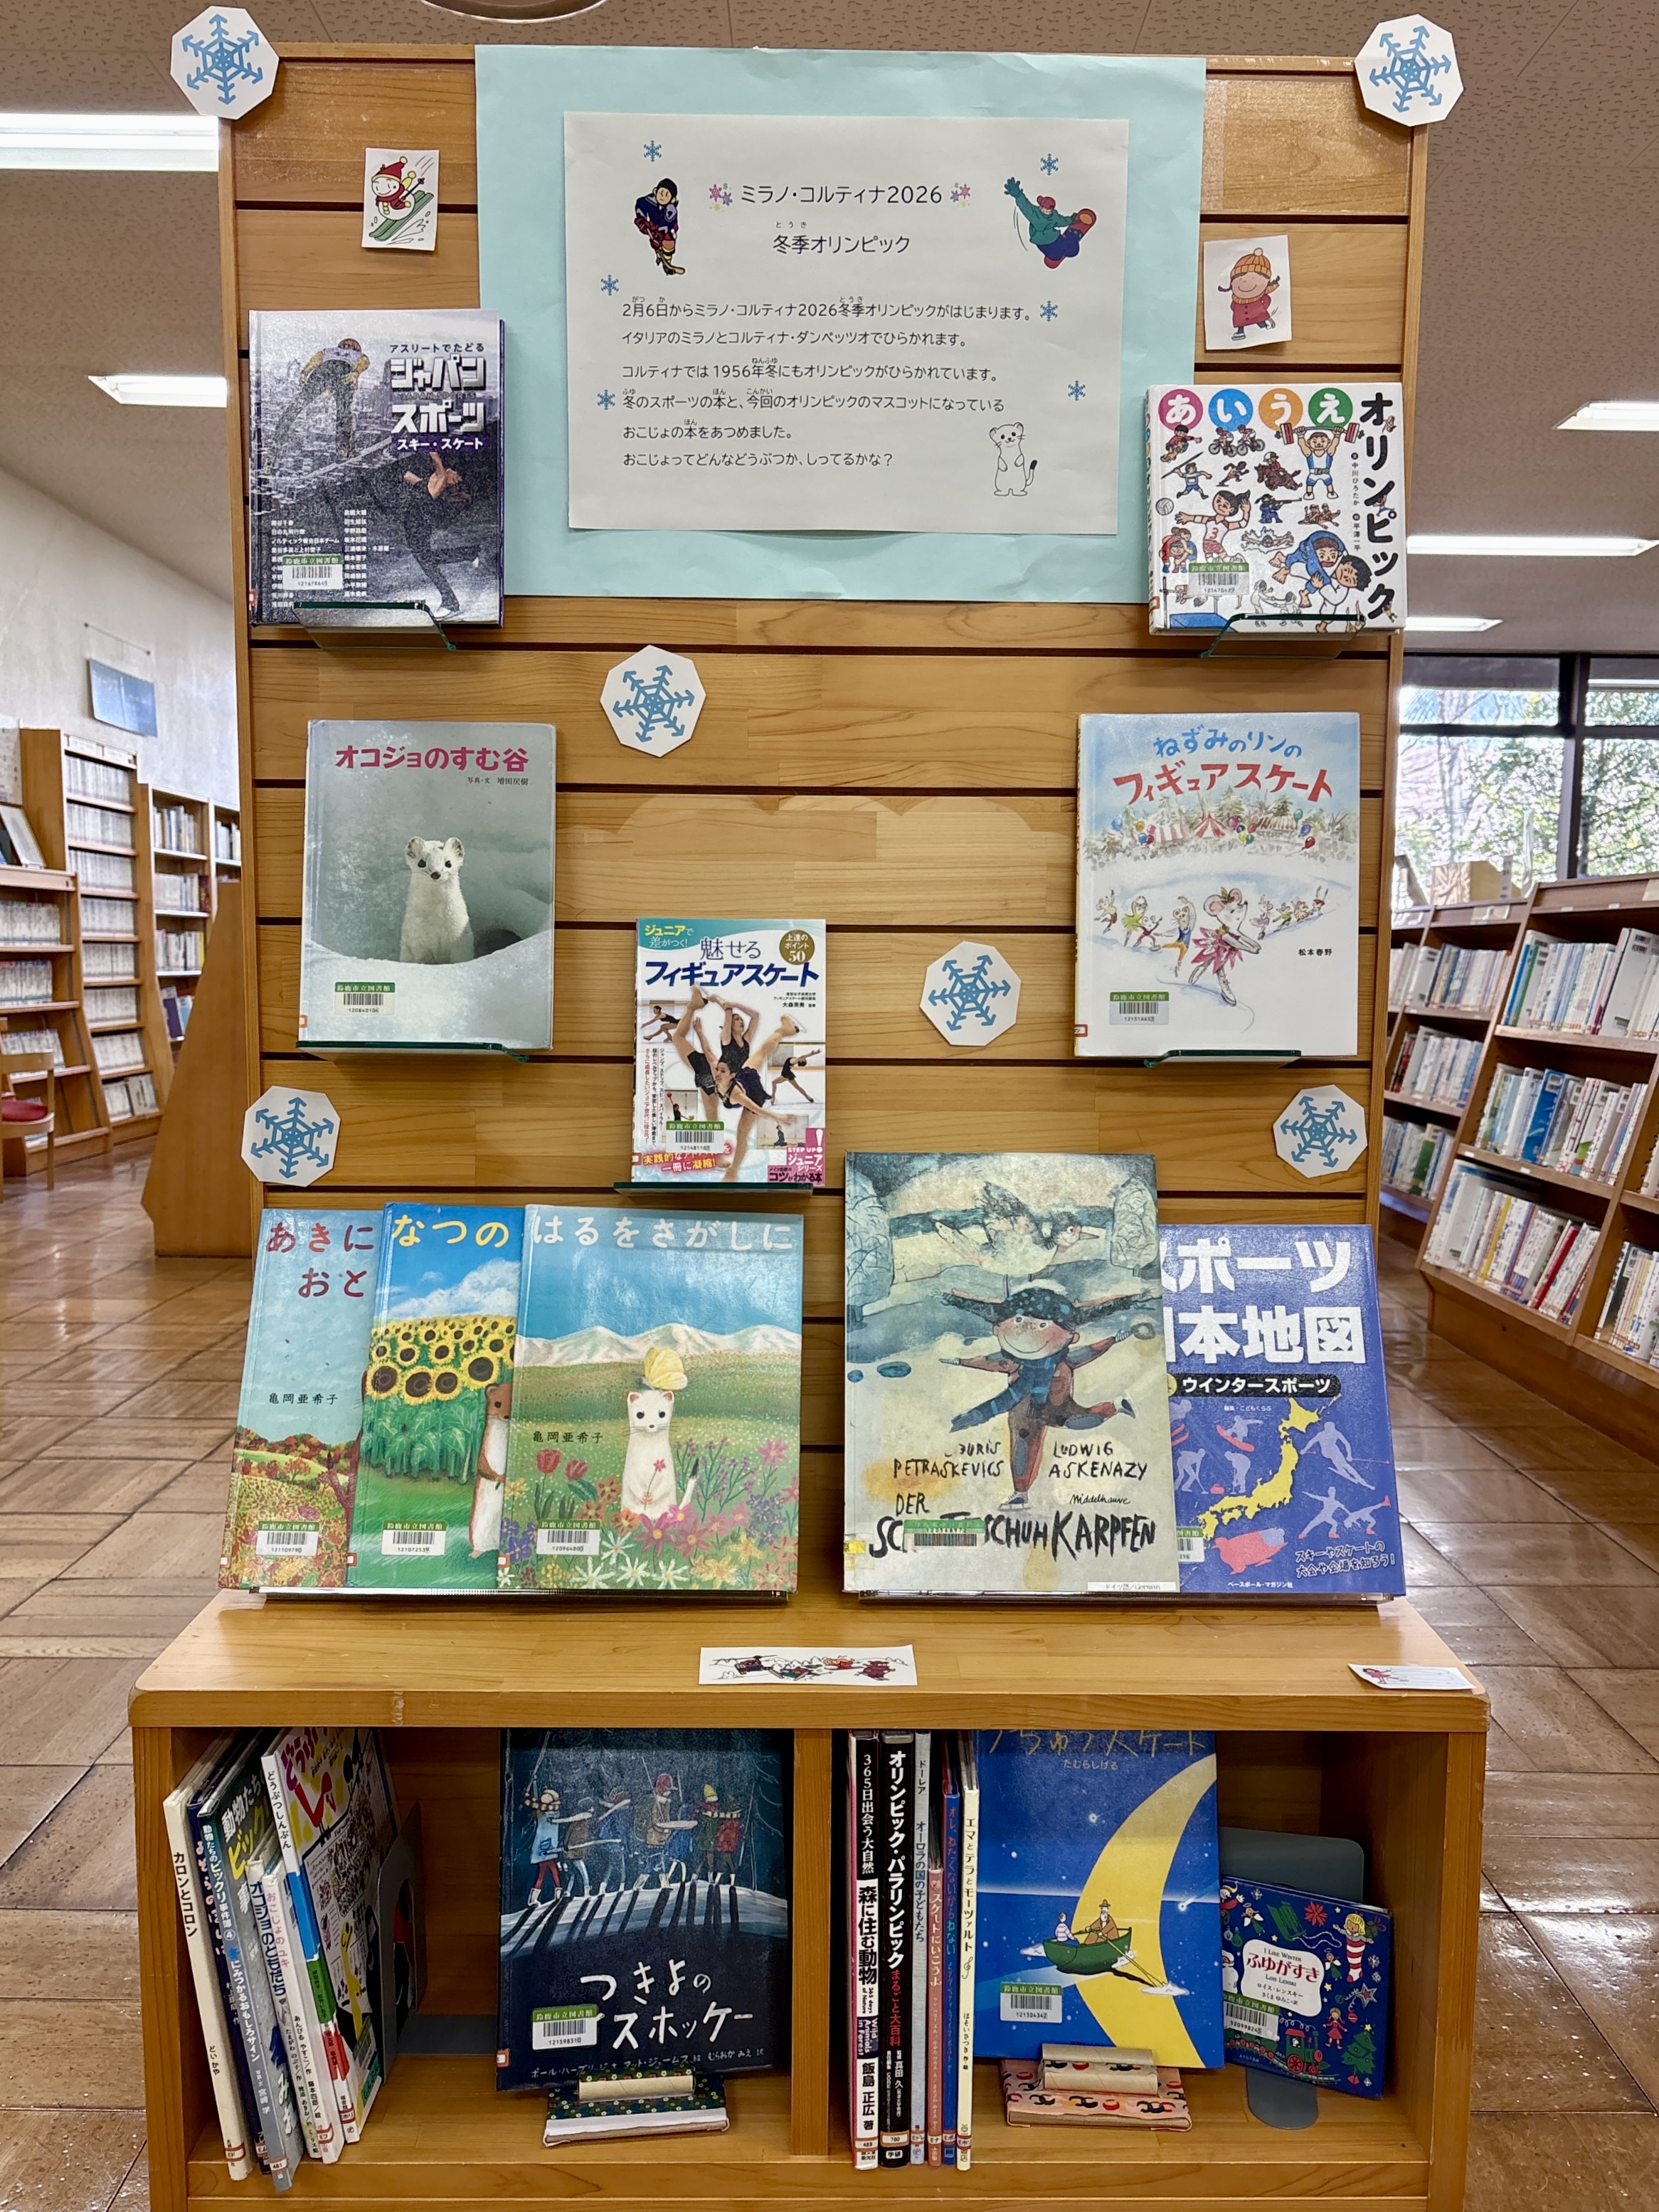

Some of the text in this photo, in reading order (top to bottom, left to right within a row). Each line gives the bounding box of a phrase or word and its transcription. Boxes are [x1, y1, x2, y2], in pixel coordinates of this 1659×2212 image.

[741, 185, 943, 204] ミラノ・コルティナ2026
[775, 221, 807, 229] とうき
[773, 234, 911, 255] 冬季オリンピック
[622, 303, 1029, 320] 2月6日からミラノ・コルティナ2026冬季オリンピックがはじまります。
[390, 343, 484, 353] アスリートでたどる
[391, 354, 487, 391] ジャパン
[401, 392, 434, 401] JAPAN
[623, 395, 1005, 412] 冬のスポーツの本と、今回のオリンピックのマスコットになっている
[1166, 393, 1345, 425] あいうえ
[391, 399, 486, 433] スポーツ
[397, 438, 483, 450] スキー・スケート
[623, 425, 792, 440] おこじょの本をあつめました。
[1359, 392, 1399, 619] オリンピック
[1153, 724, 1303, 758] ねずみのリンの
[336, 745, 529, 773] オコジョのすむ谷
[1112, 760, 1333, 805] フィギュアスケート
[645, 924, 694, 937] ジュニアで
[650, 936, 688, 948] 差がつく!
[700, 937, 761, 961] 魅せる
[788, 951, 806, 963] 50
[1298, 948, 1333, 956] 松本春野
[645, 961, 820, 988] フィギュアスケート
[788, 1154, 823, 1166] ジュニア
[265, 1222, 374, 1253] あきに
[392, 1214, 509, 1248] なつの
[534, 1216, 793, 1251] はるをさがしに
[298, 1267, 368, 1298] おと
[1162, 1305, 1366, 1365] 本地図
[1182, 1376, 1332, 1395] ウインタースポーツ
[268, 1392, 339, 1406] 亀岡亜希子
[533, 1430, 603, 1444] 亀岡亜希子
[1053, 1441, 1113, 1458] LUDWIG
[1049, 1459, 1147, 1481] ASKENAZY
[895, 1492, 930, 1516] DER
[1295, 1540, 1386, 1563] スキーやスケートの
[917, 1759, 926, 1795] ドーレア
[1062, 1758, 1118, 1770] たむらしげる
[267, 1770, 292, 1849] どうぶつしんぶん
[862, 1754, 874, 1874] 365日出会う大自然
[887, 1750, 906, 1970] オリンピック・パラリンピック
[173, 1852, 198, 1937] カロンとコロン
[914, 1821, 926, 1943] オーロラの国の子どもたち
[963, 1818, 977, 1952] エマとテラとモーツァルト
[266, 1893, 290, 1968] おこじょのユキ
[858, 1886, 877, 1985] 森に住む動物
[928, 1893, 943, 1986] スケートにいこうよ
[1246, 1952, 1320, 1983] ふゆがすき
[580, 1959, 712, 2005] つきよの
[889, 1970, 901, 2047] まるごと大百科
[294, 2016, 304, 2041] あんびる
[597, 2001, 753, 2051] スホッケー
[863, 2019, 872, 2053] Animals
[862, 2062, 876, 2087] 飯島
[895, 2061, 903, 2078] 真田
[894, 2080, 903, 2089] 久
[862, 2090, 876, 2116] 正広
